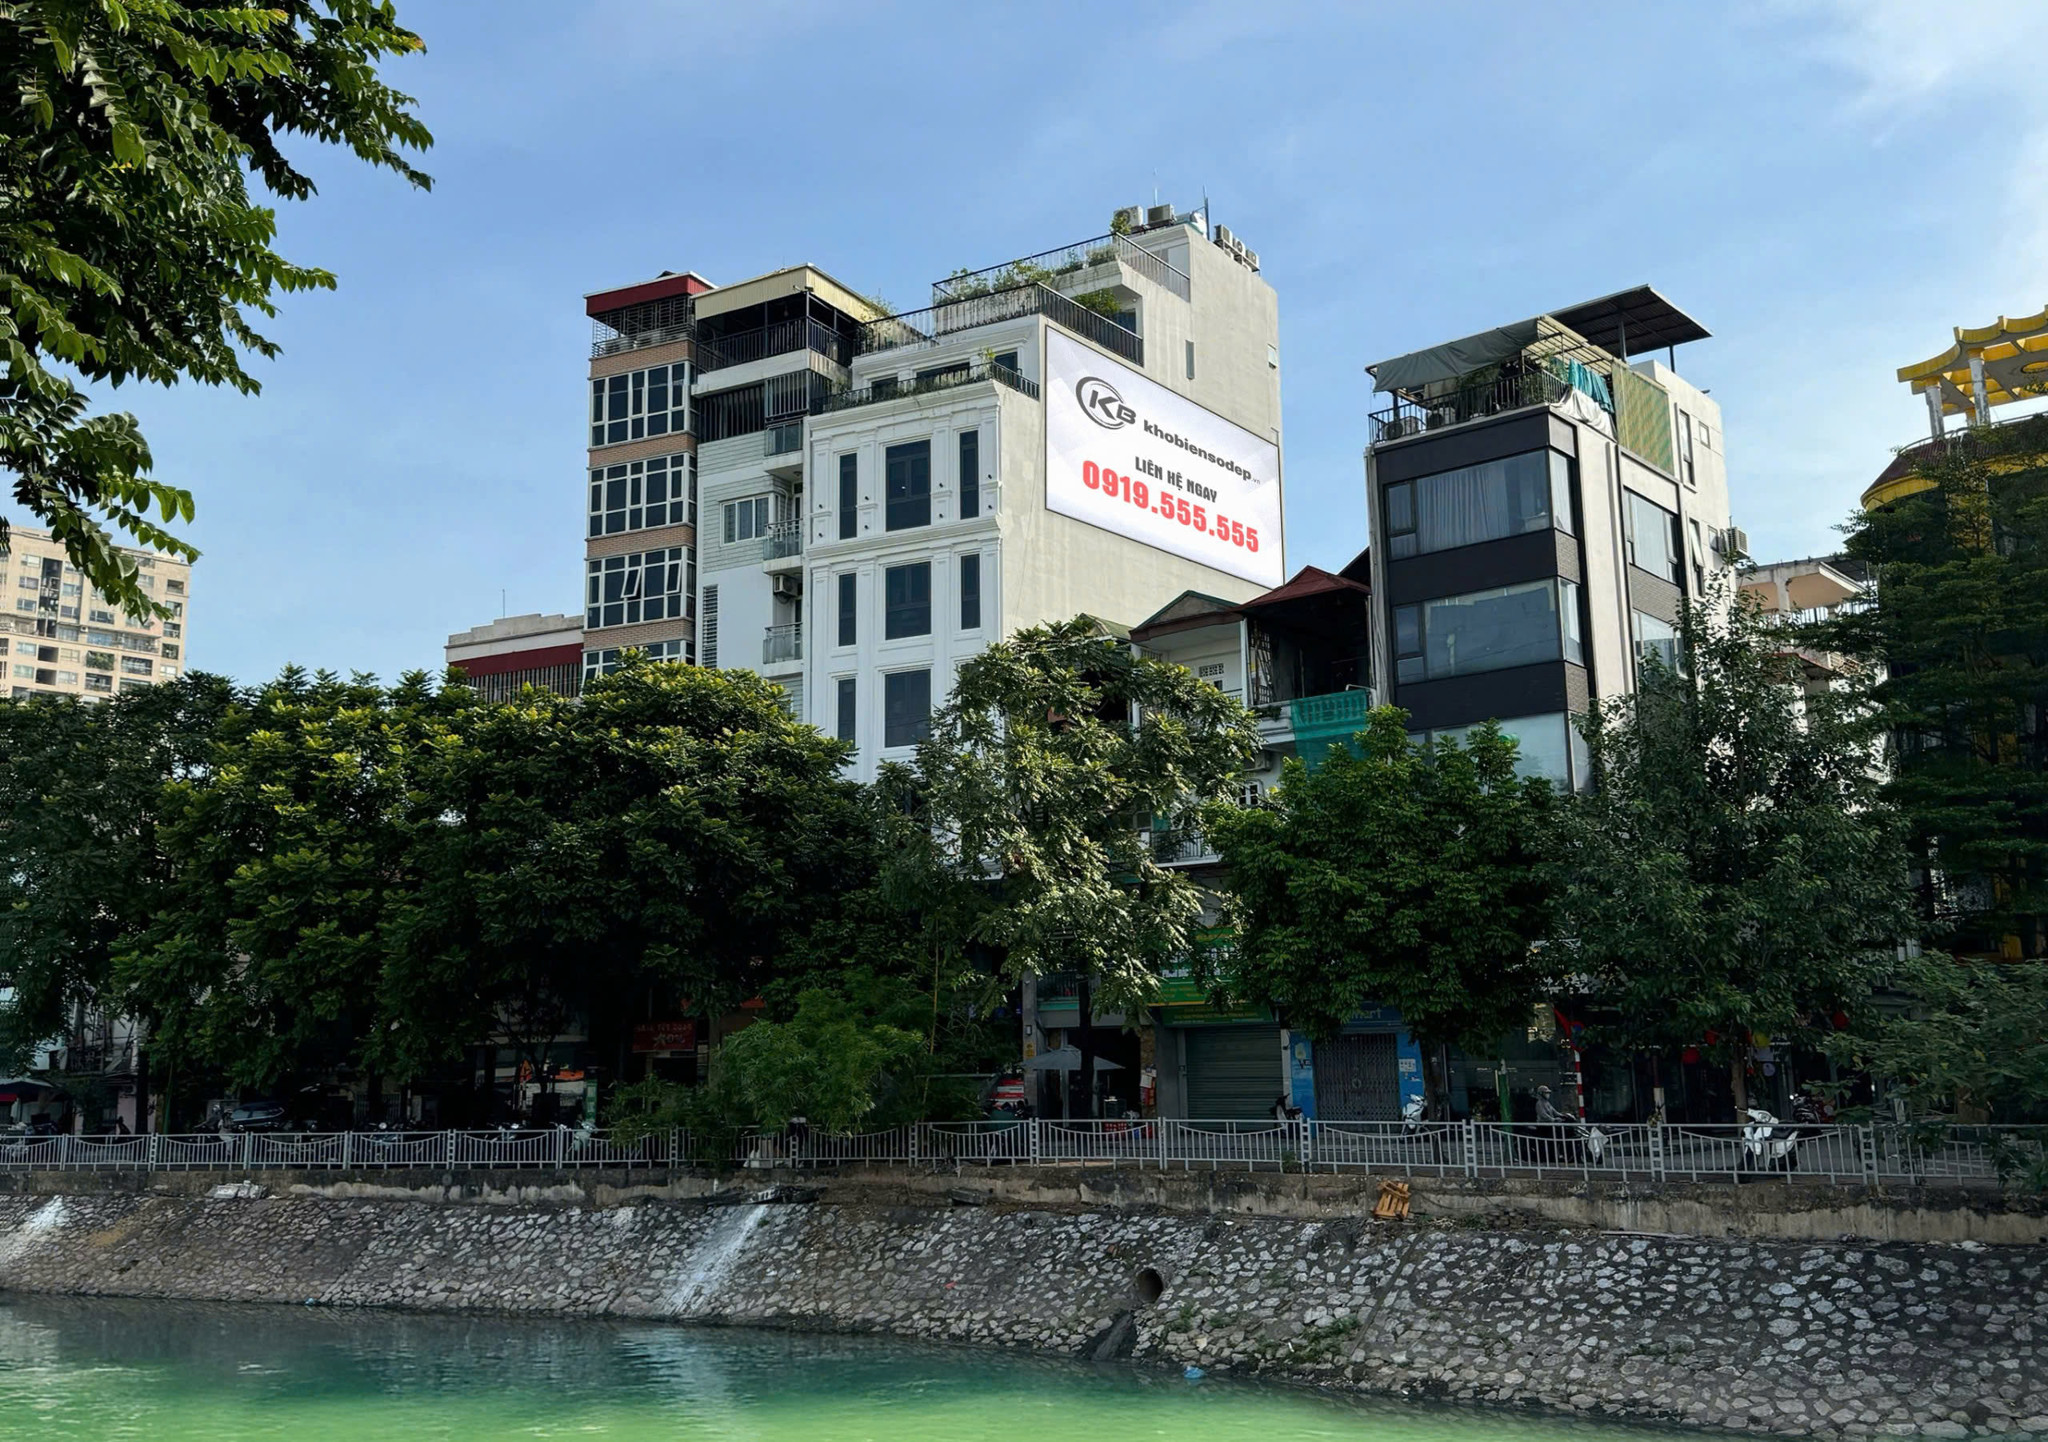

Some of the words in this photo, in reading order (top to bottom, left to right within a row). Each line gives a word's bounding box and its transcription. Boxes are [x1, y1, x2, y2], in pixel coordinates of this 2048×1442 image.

[1089, 389, 1137, 425] KB
[1135, 456, 1163, 481] LIÊN
[1167, 471, 1183, 491] HỆ
[1187, 480, 1218, 503] NGAY
[1082, 460, 1259, 553] 0919.555.555
